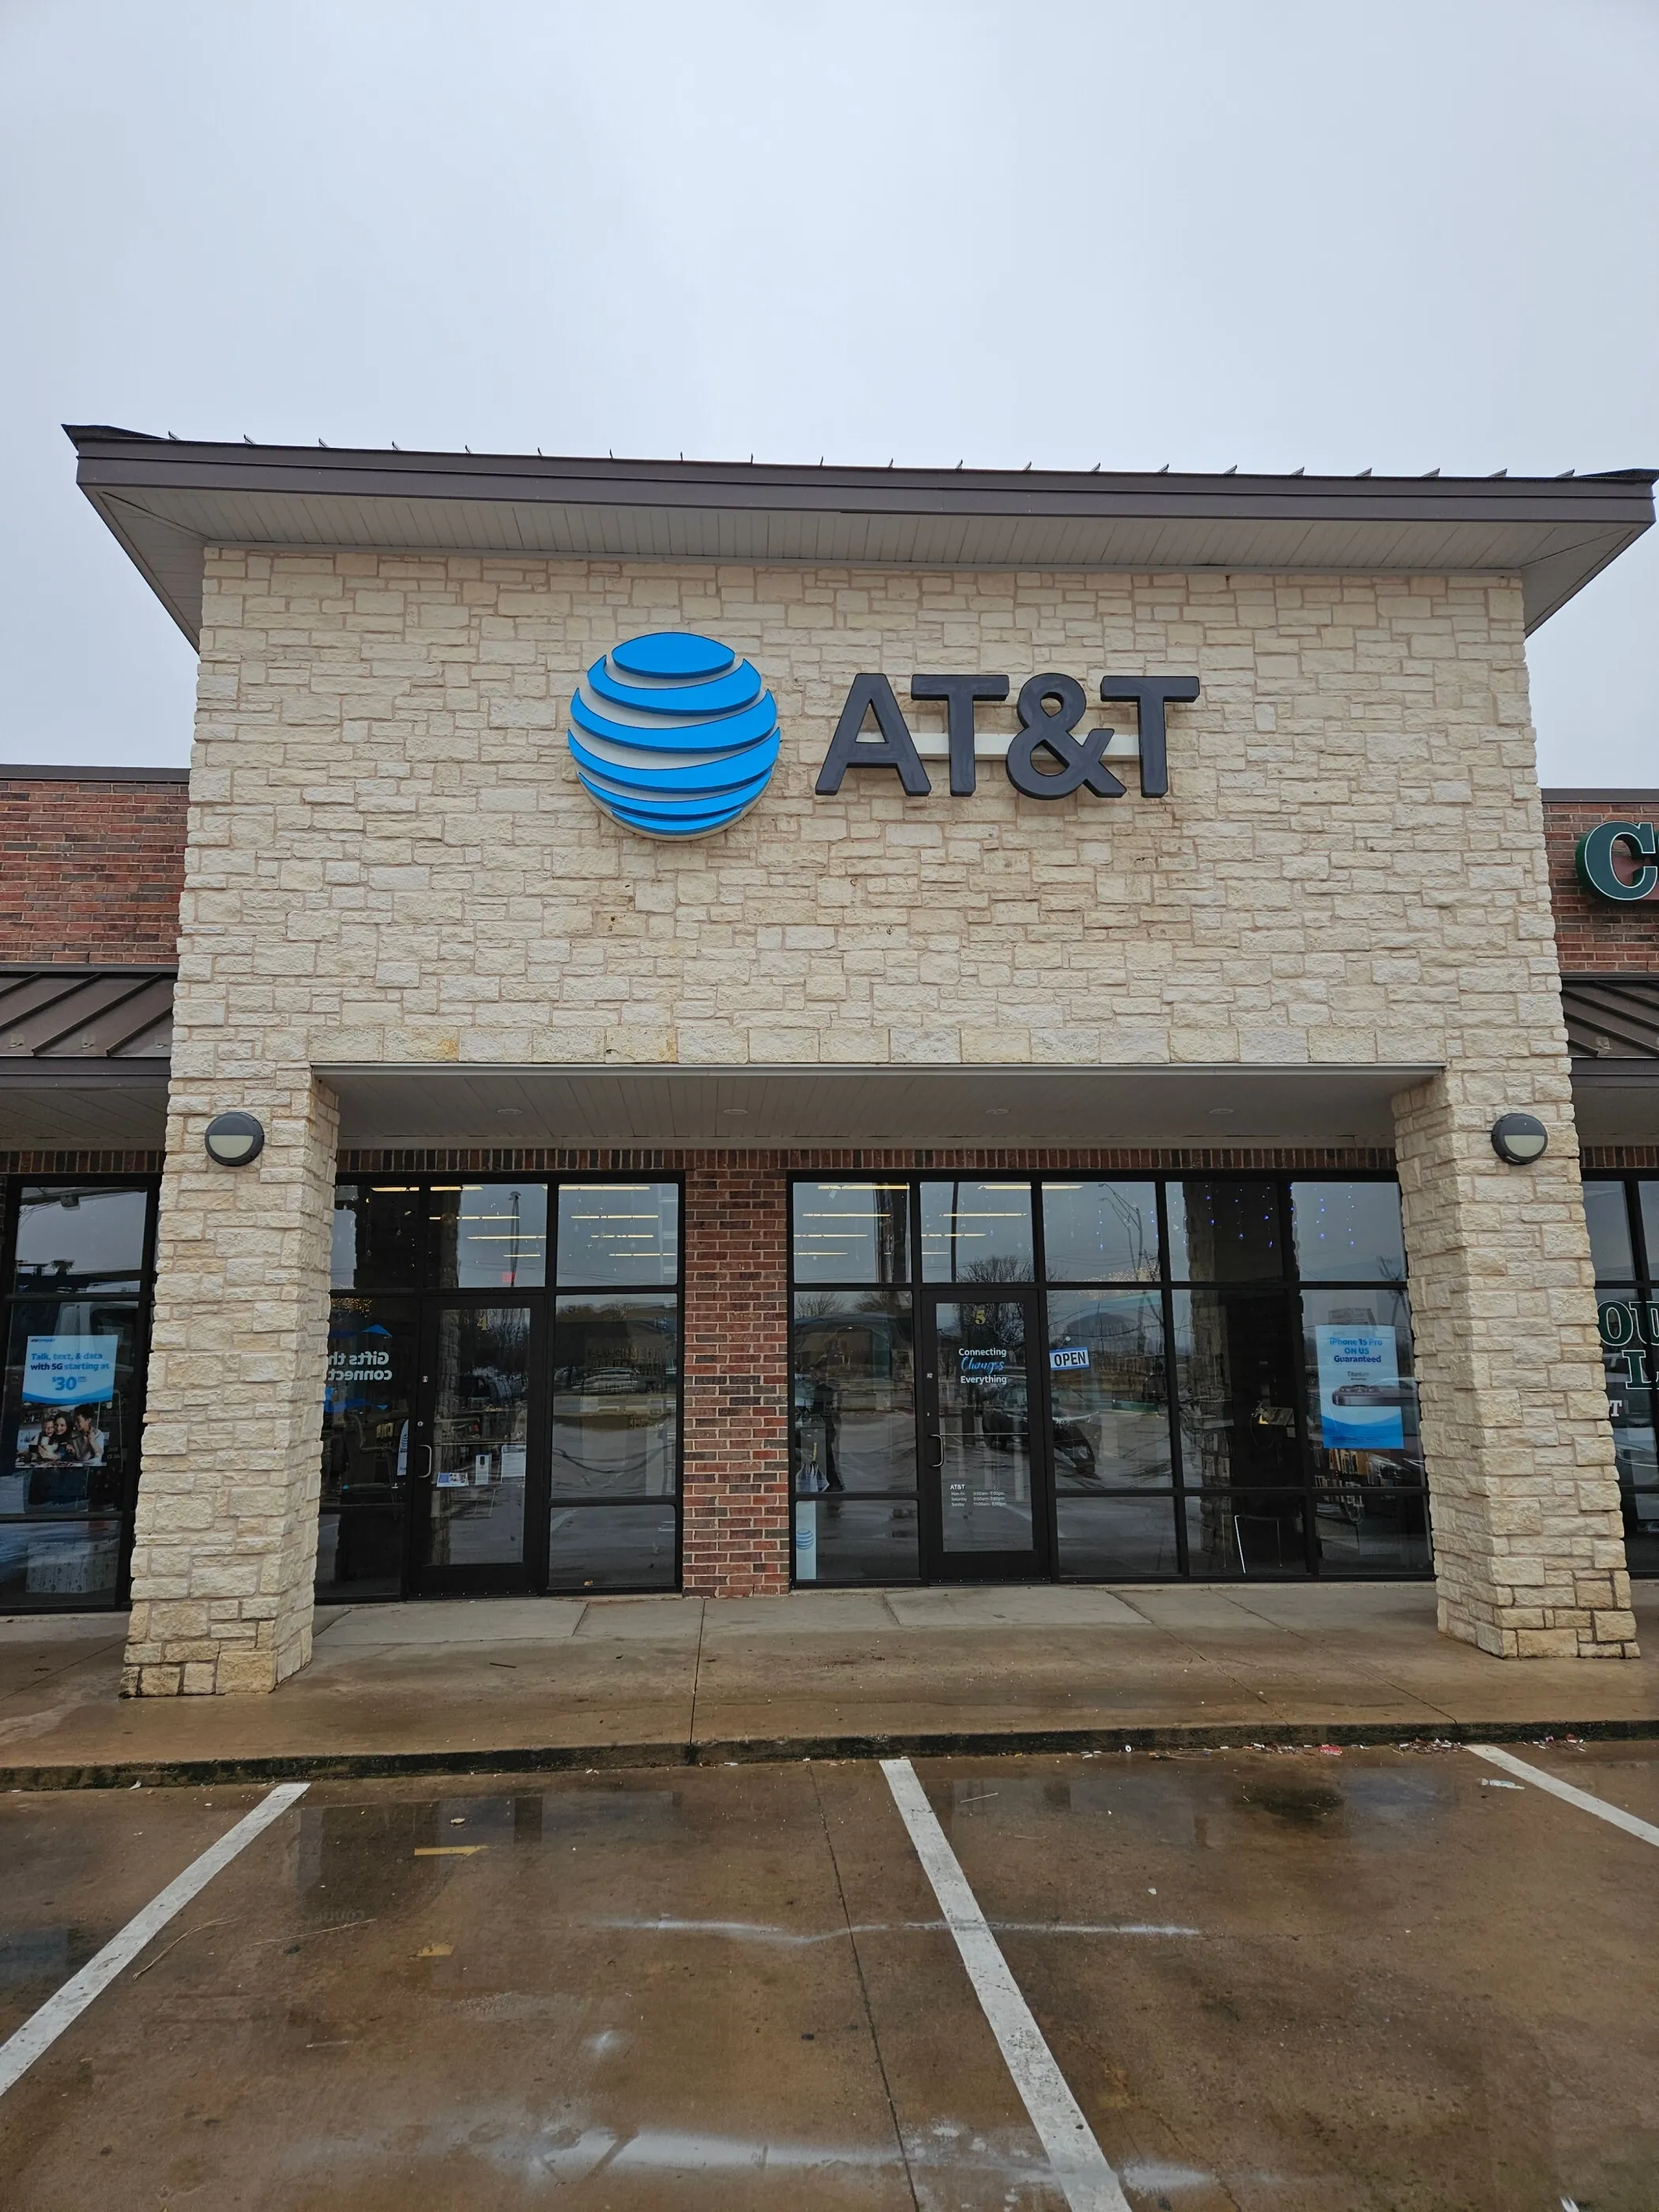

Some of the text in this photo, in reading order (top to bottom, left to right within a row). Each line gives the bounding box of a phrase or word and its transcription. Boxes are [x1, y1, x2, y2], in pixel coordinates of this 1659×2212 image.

[815, 672, 1200, 800] AT&T
[476, 1313, 488, 1331] 4
[974, 1309, 986, 1325] 5
[1330, 1337, 1357, 1346] iPhone
[1369, 1337, 1383, 1346] Pro
[958, 1348, 1006, 1357] Connecting
[1054, 1352, 1086, 1367] OPEN
[30, 1362, 50, 1371] with
[64, 1362, 99, 1371] starting
[961, 1356, 1005, 1374] Changes
[51, 1376, 77, 1391] $30
[960, 1375, 1007, 1386] Everything
